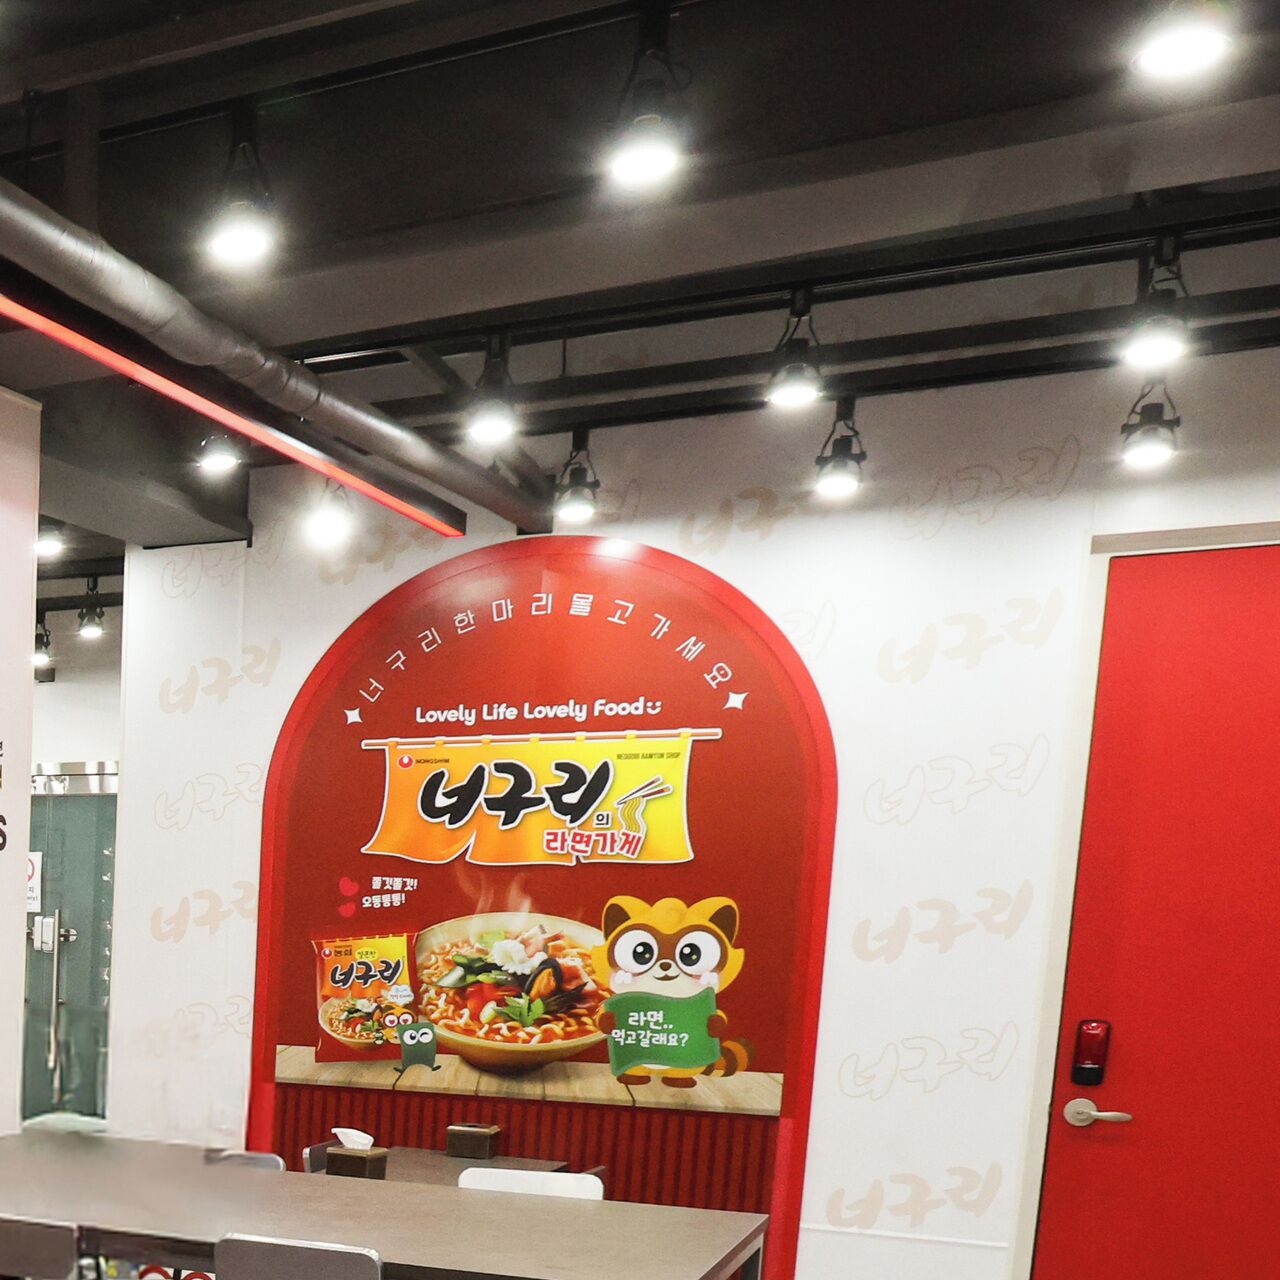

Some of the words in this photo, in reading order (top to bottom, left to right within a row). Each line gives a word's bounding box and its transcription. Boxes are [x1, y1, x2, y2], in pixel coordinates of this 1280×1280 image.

[415, 700, 476, 726] Lovely
[482, 701, 517, 722] Life
[523, 699, 588, 723] Lovely
[593, 697, 645, 717] Food
[419, 759, 615, 830] 너구리
[595, 811, 612, 827] 의
[544, 829, 642, 860] 라면가게
[330, 958, 403, 989] 너구리
[611, 1030, 689, 1049] 먹고갈래요?
